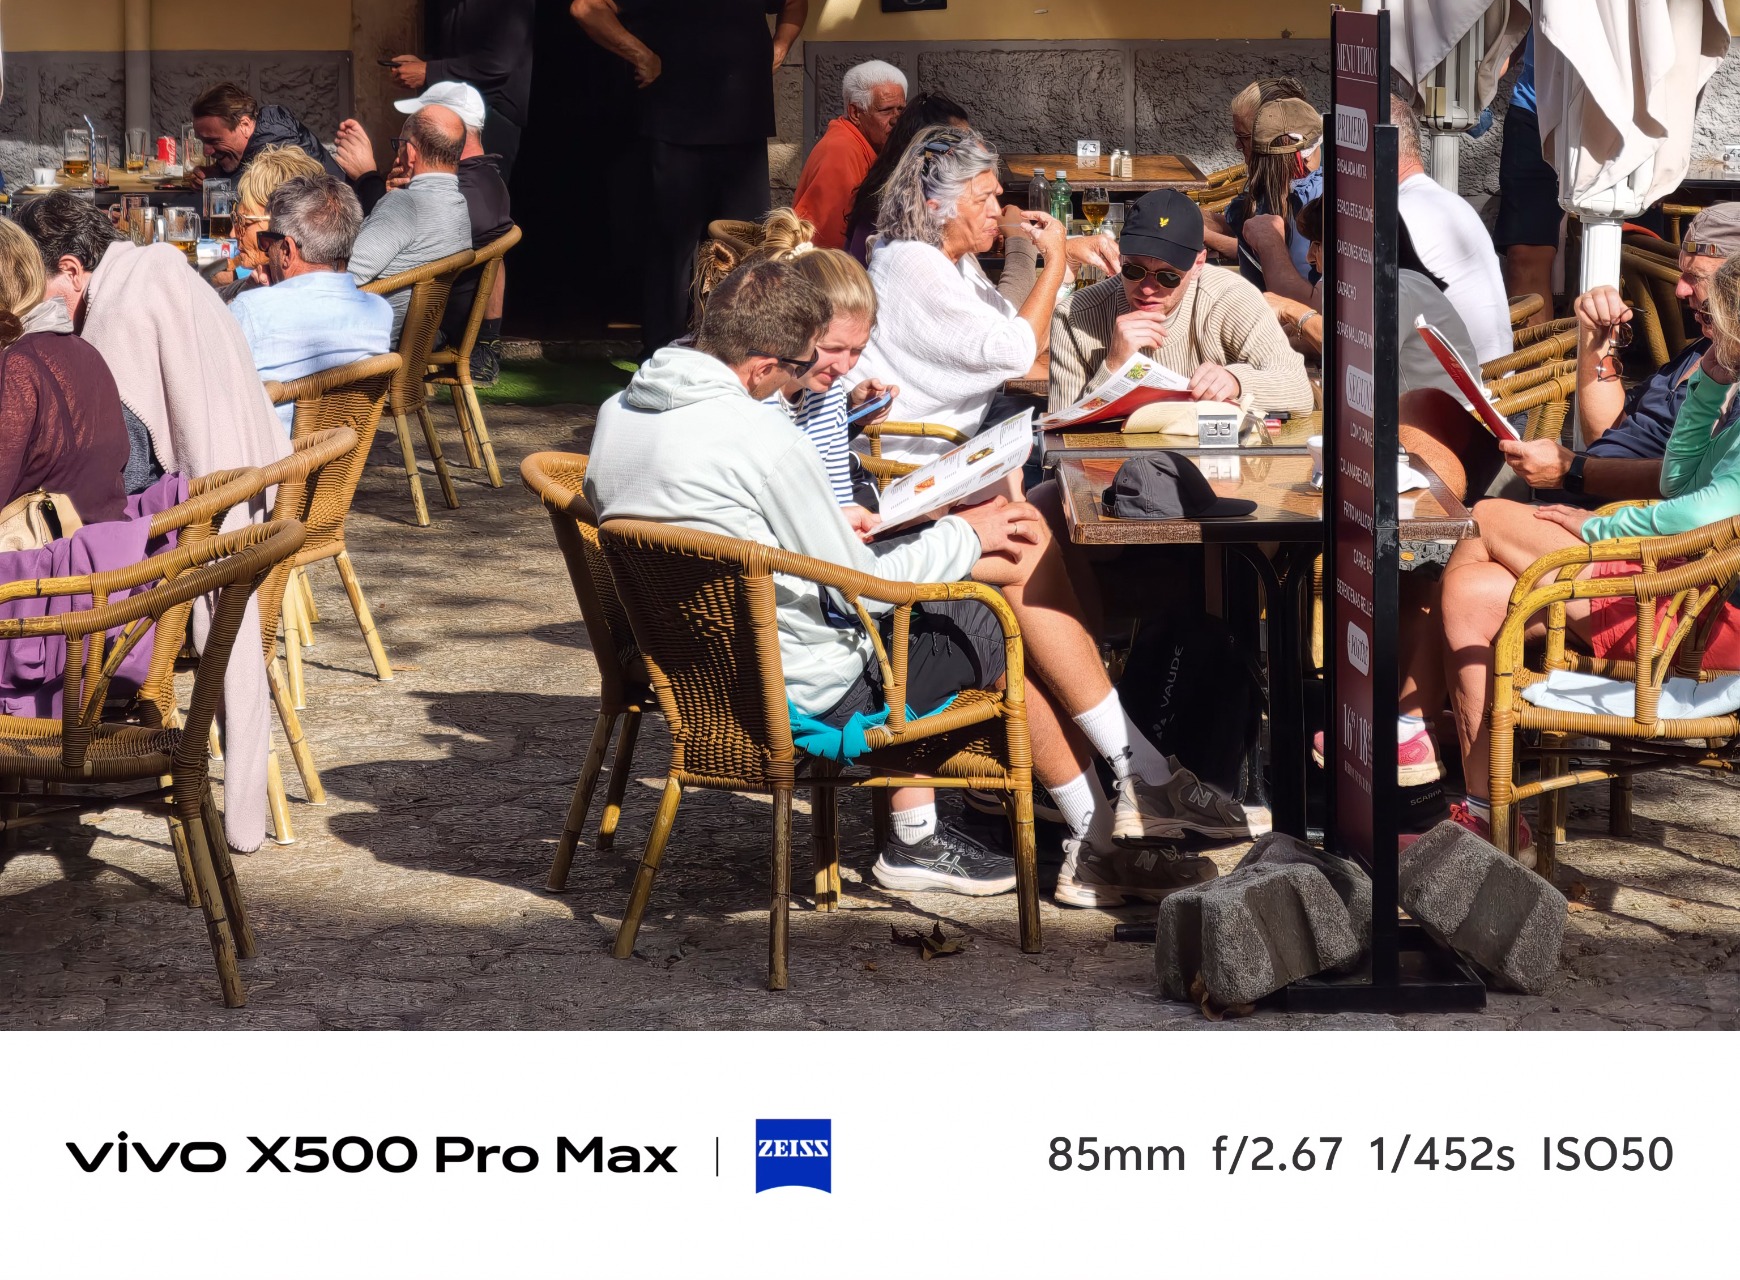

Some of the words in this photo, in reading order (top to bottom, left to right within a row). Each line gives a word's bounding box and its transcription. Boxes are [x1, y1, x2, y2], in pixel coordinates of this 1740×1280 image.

[1337, 112, 1367, 148] PRIMERO
[1206, 421, 1231, 437] 33
[1160, 645, 1184, 708] VAUDE
